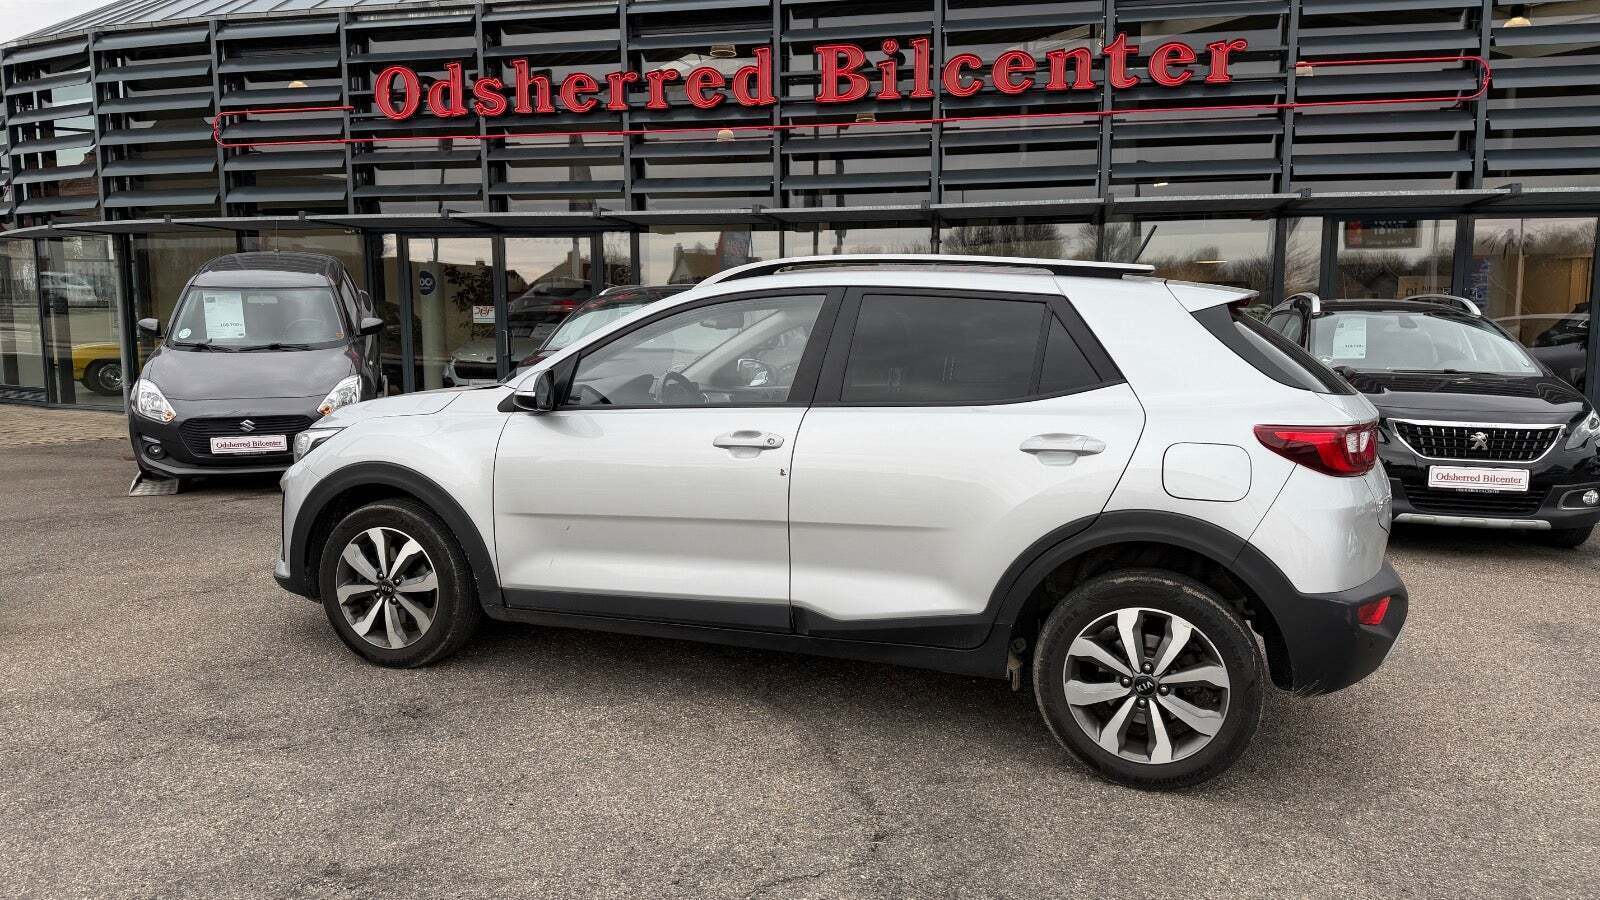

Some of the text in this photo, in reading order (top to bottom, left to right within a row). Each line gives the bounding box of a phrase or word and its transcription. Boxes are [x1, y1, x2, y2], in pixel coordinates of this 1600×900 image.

[373, 32, 1248, 120] Odsherred Bilcenter
[216, 440, 282, 449] Odsherred Bilcenter
[1436, 472, 1522, 484] Odsherred Bilcenter
